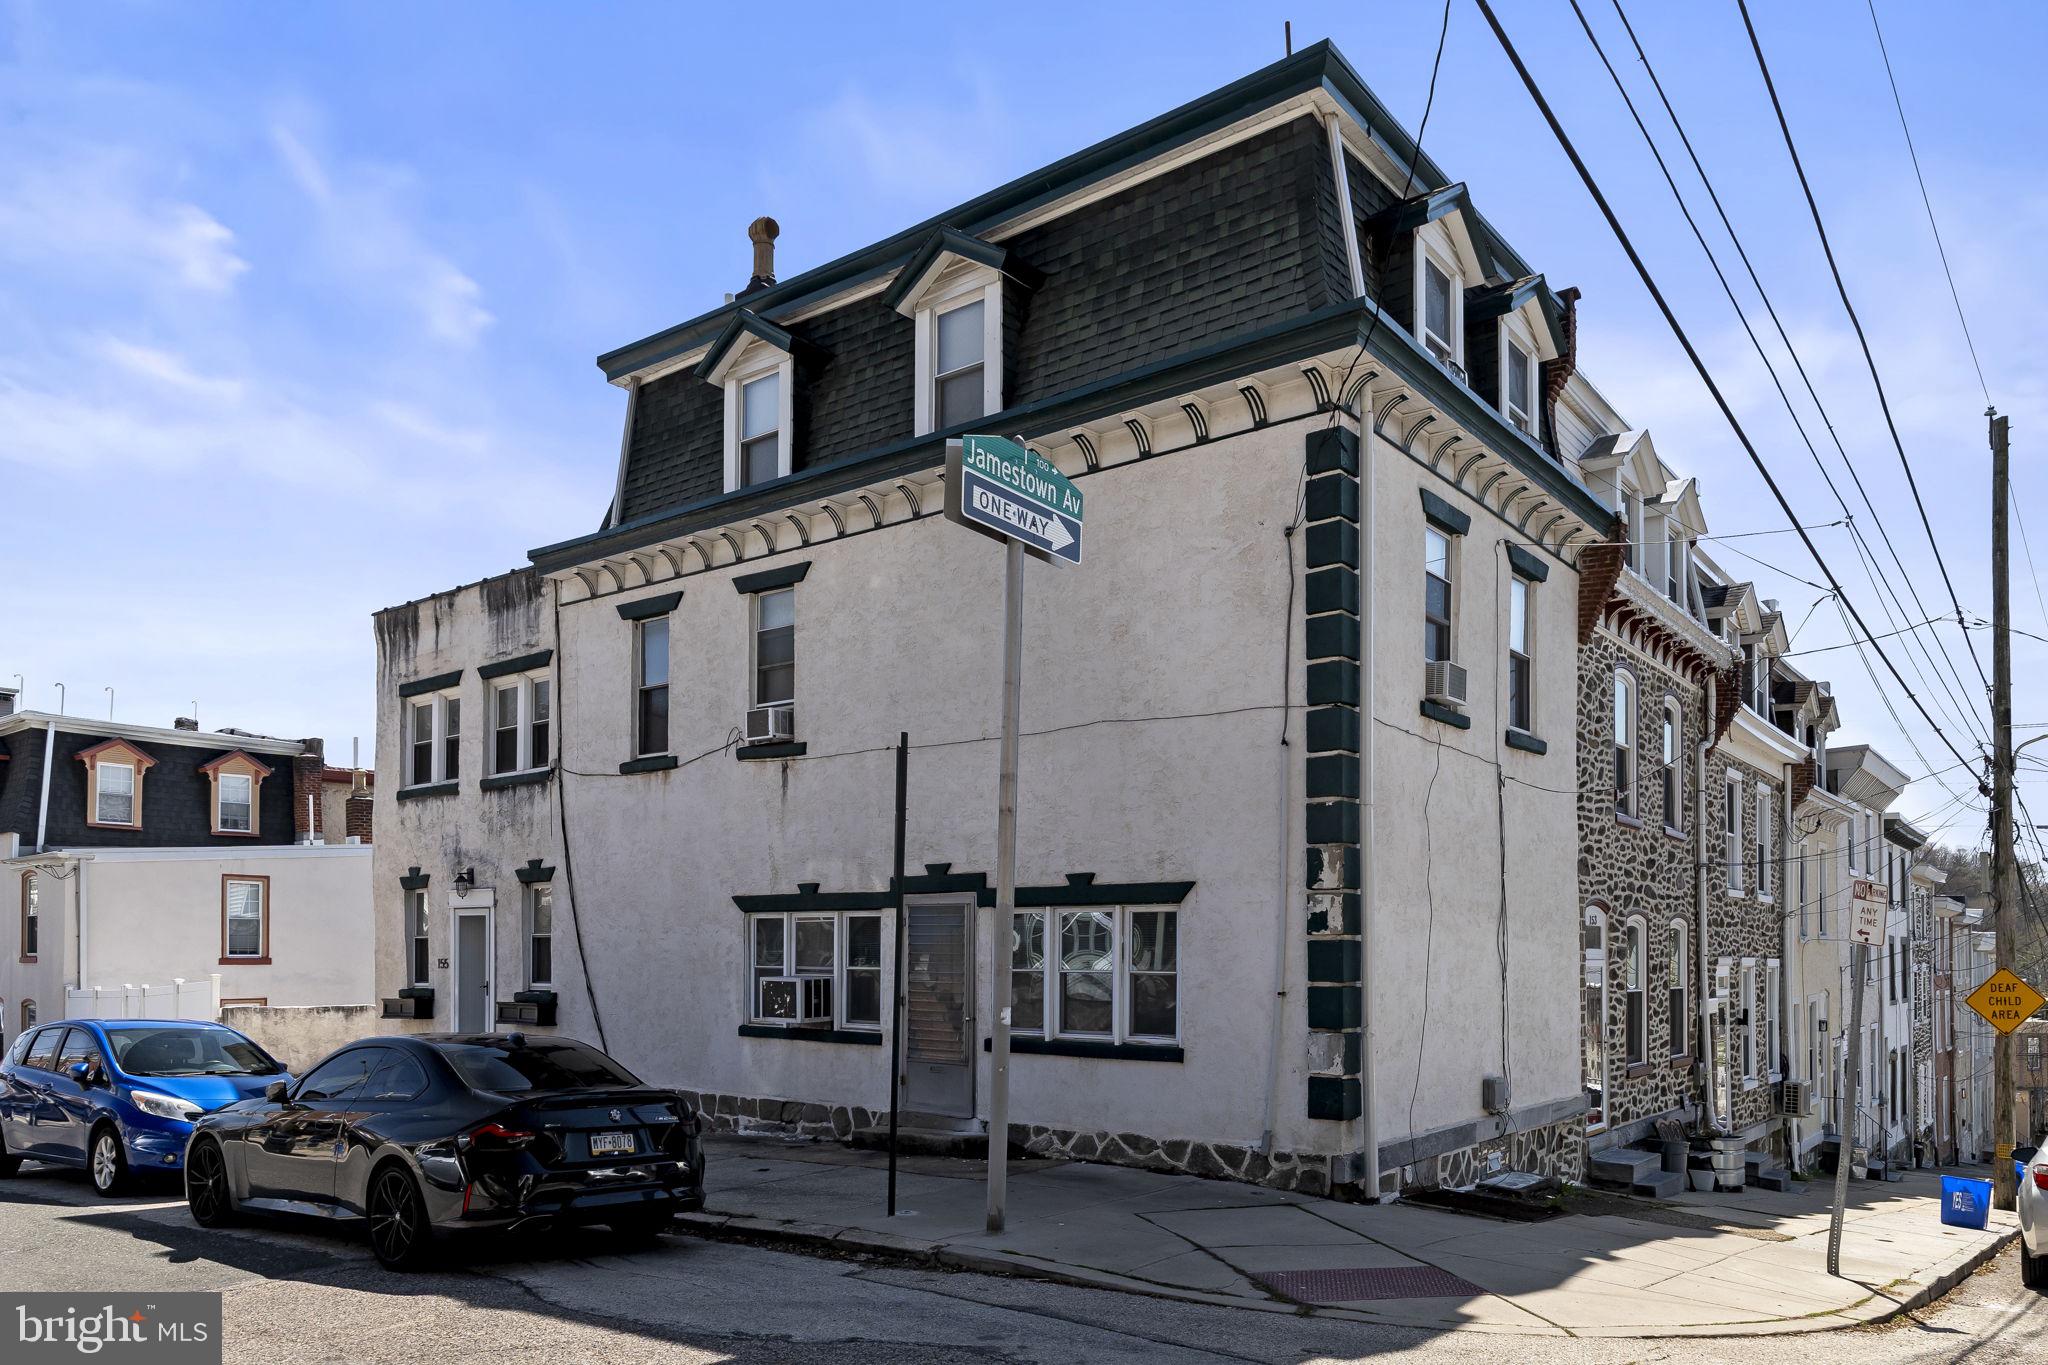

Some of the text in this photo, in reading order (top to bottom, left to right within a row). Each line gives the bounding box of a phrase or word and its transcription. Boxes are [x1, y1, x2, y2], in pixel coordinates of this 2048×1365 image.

[967, 438, 1081, 514] Jamestown Av
[979, 491, 1049, 536] ONE WAY
[1854, 883, 1866, 898] NO
[1860, 906, 1878, 917] ANY
[1589, 915, 1598, 926] 153
[1859, 916, 1877, 927] TIME
[1990, 983, 2018, 992] DEAF
[1988, 996, 2022, 1006] CHILD
[1991, 1009, 2020, 1019] AREA
